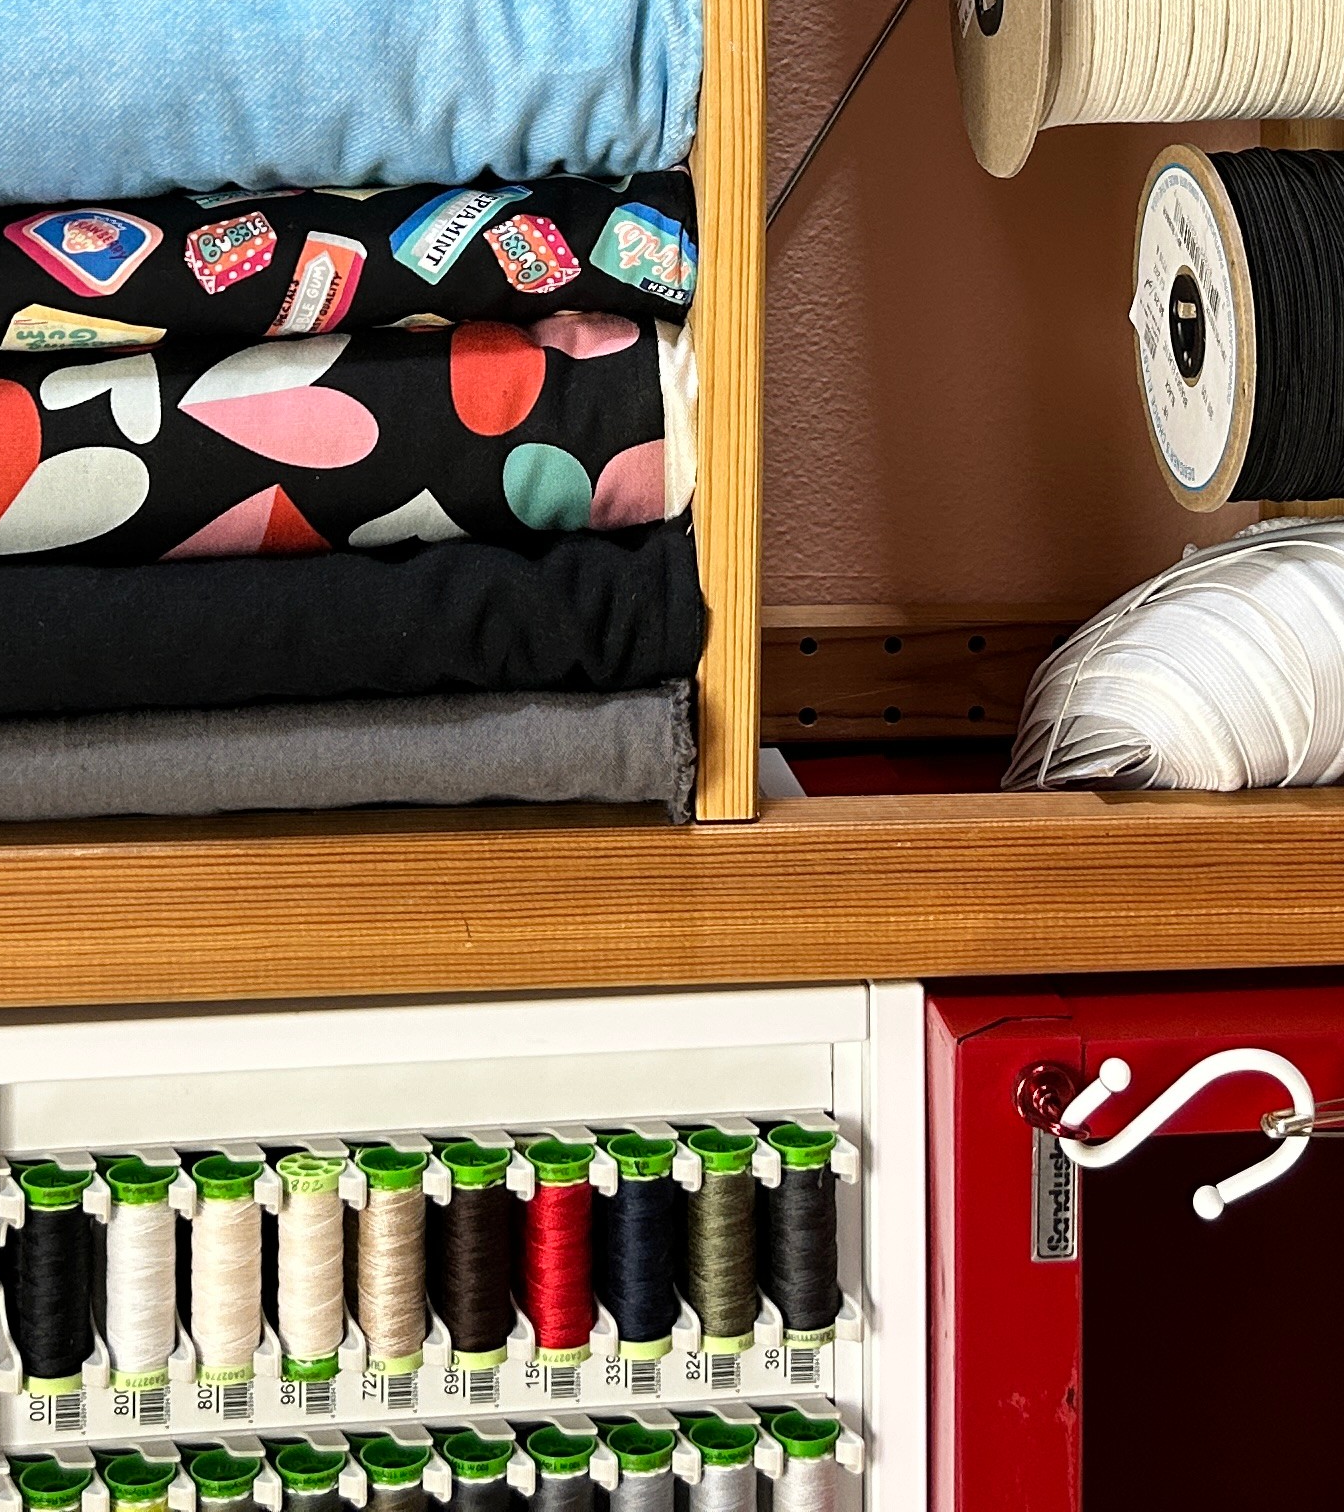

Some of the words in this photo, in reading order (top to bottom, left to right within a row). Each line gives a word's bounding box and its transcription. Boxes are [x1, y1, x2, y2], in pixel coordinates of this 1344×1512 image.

[196, 216, 269, 265] BUBBLE
[424, 220, 467, 268] MINT
[491, 219, 549, 284] BUBBLE
[305, 264, 328, 299] GUM
[318, 269, 343, 317] QUALITY
[290, 1179, 325, 1194] 802
[1046, 1136, 1072, 1252] Sandusk
[685, 1350, 702, 1381] 824
[764, 1348, 780, 1370] 36
